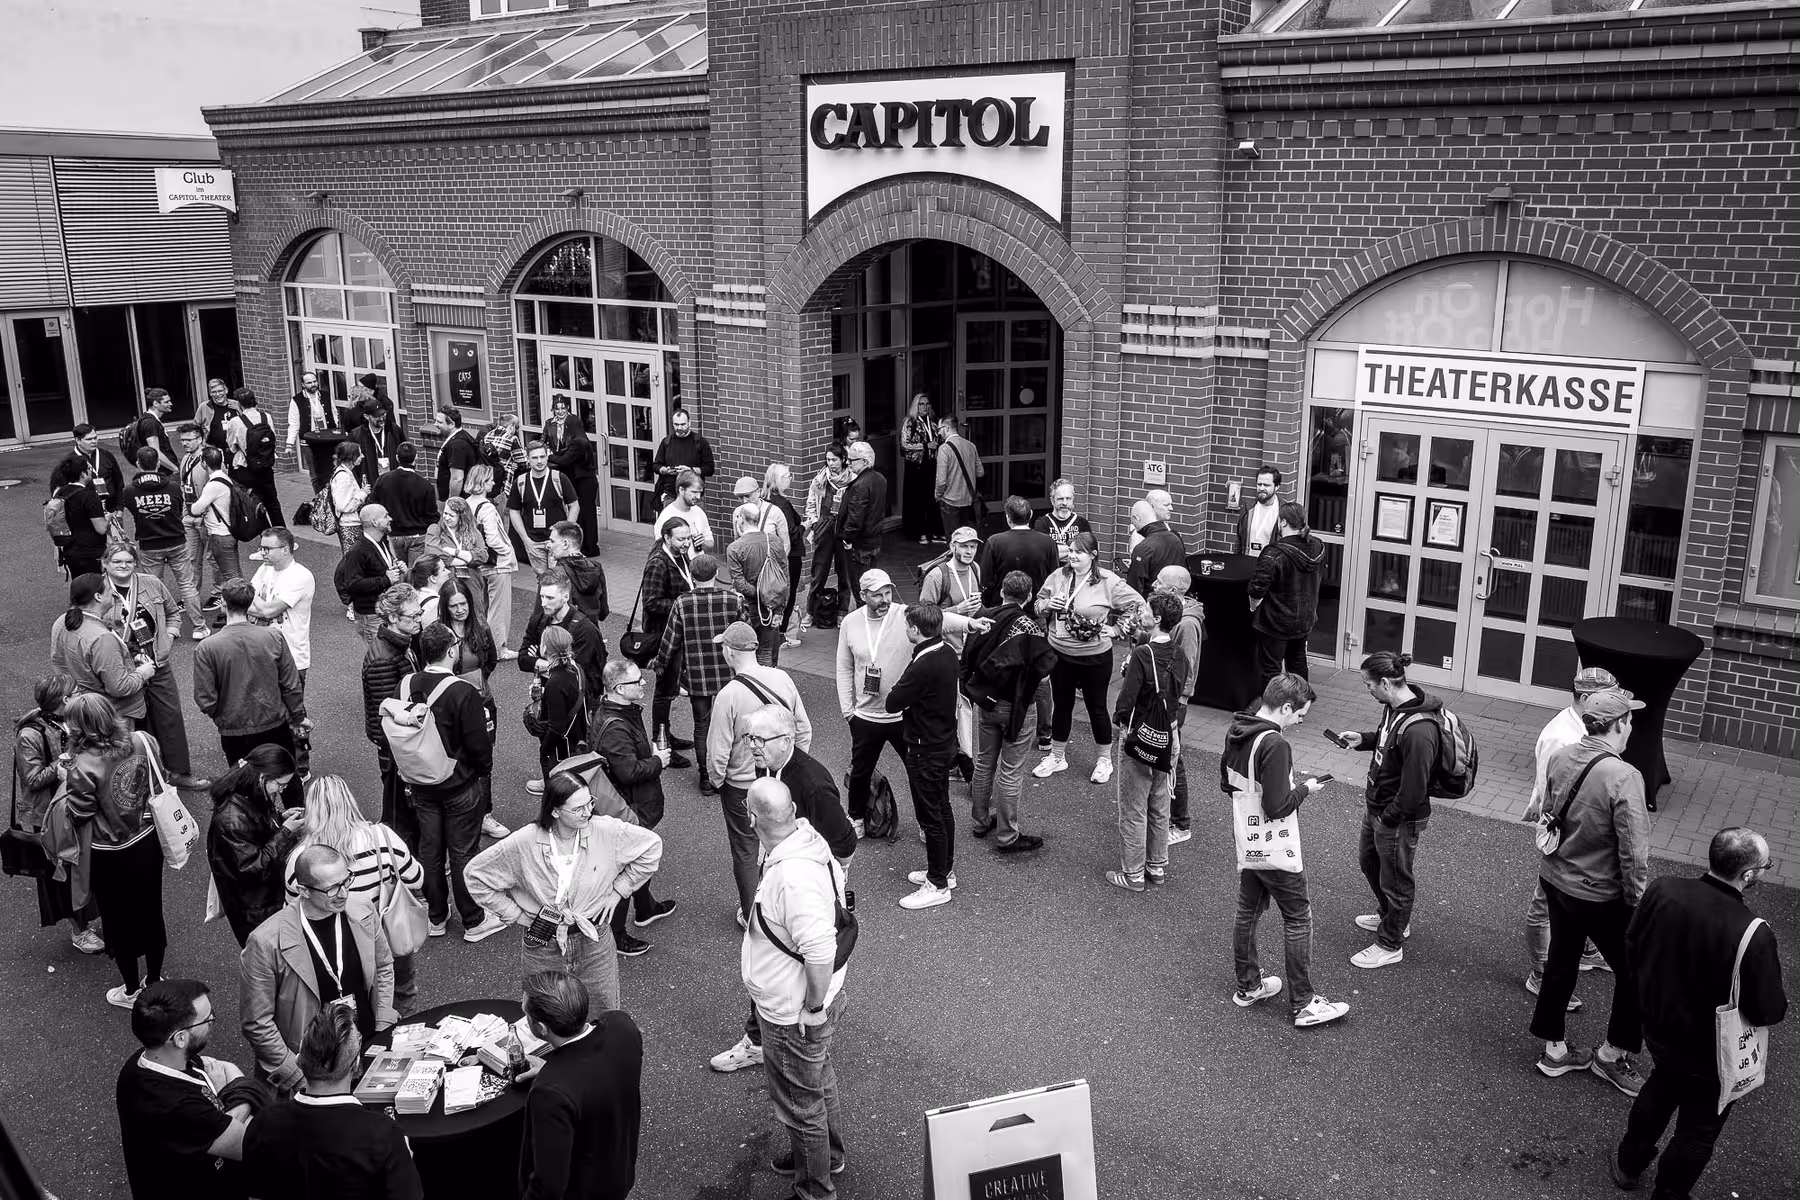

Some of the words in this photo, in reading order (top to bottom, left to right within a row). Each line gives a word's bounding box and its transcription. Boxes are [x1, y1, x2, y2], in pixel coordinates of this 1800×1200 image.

[810, 97, 1050, 150] CAPITOL
[183, 171, 215, 184] Club
[458, 371, 472, 383] CATS
[1364, 363, 1636, 414] THEATERKASSE
[134, 493, 172, 508] MEER
[984, 1169, 1048, 1199] CREATIVE
